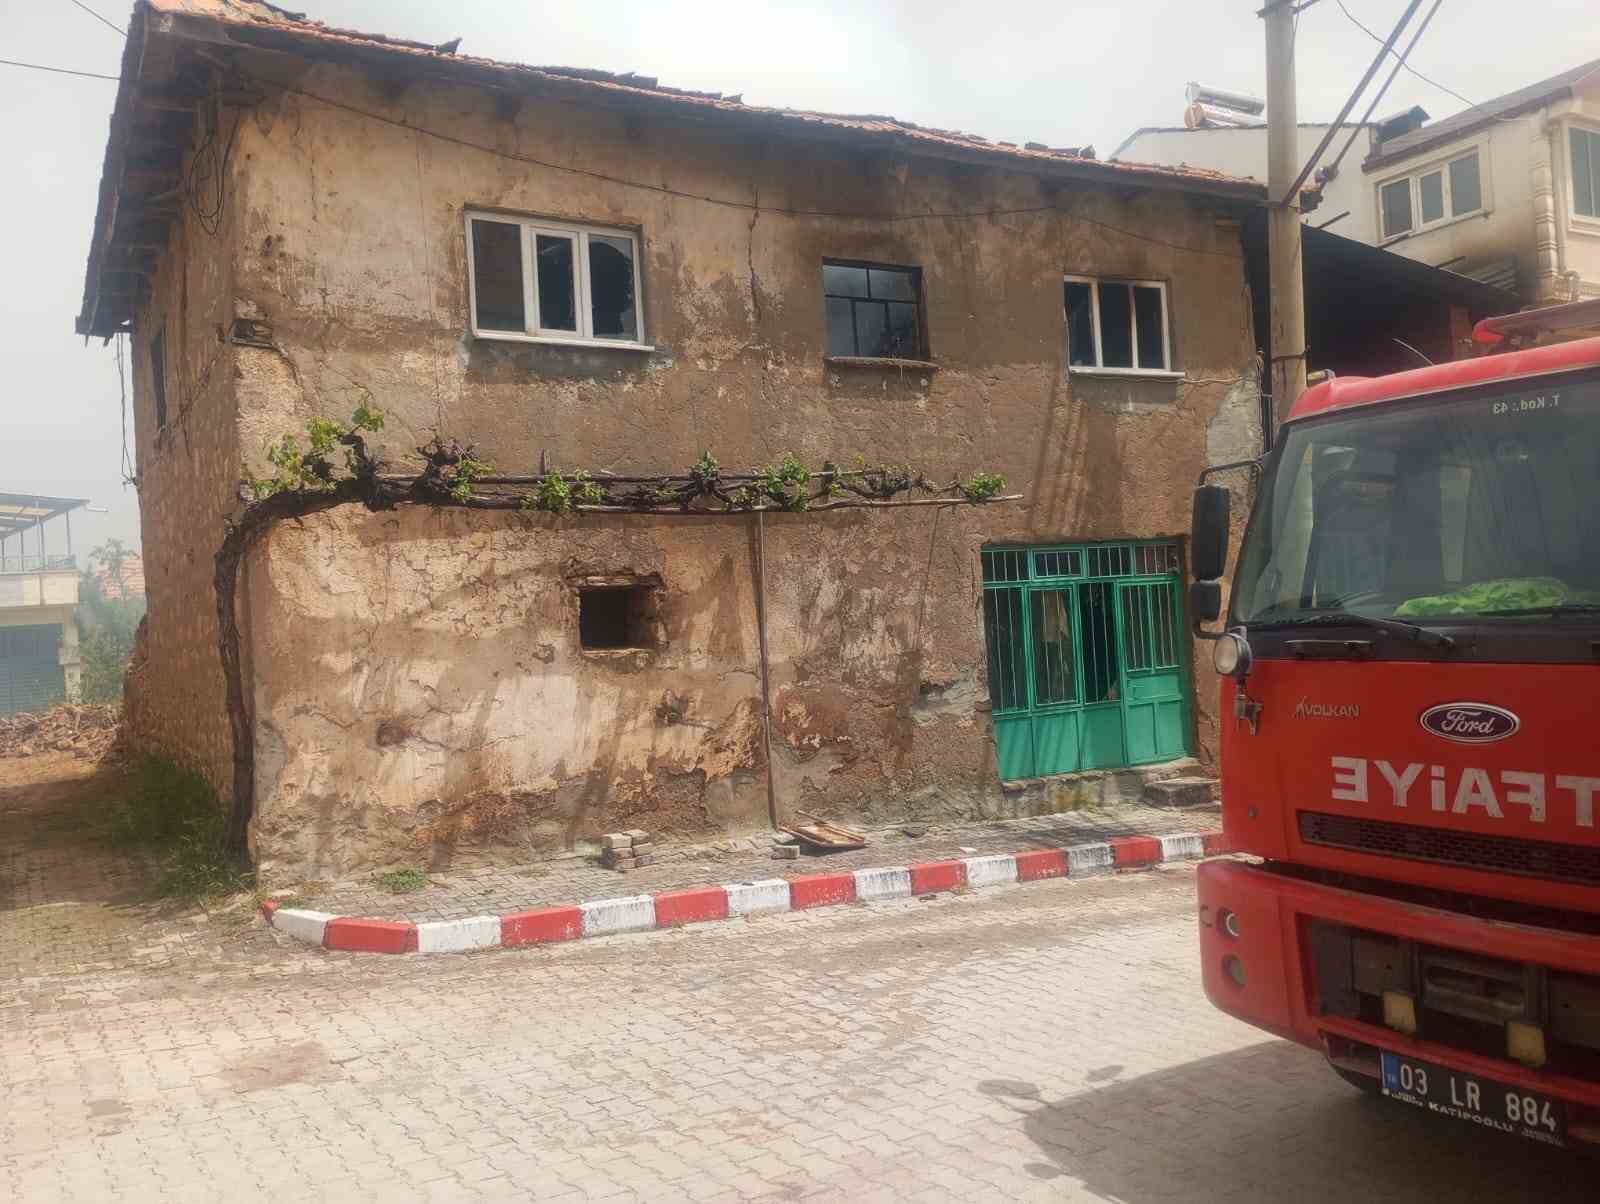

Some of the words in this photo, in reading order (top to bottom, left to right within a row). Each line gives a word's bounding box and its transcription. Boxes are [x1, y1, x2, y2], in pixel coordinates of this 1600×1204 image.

[1441, 709, 1496, 733] Ford
[1401, 1063, 1428, 1095] 03
[1450, 1076, 1480, 1111] LR
[1505, 1092, 1556, 1132] 884
